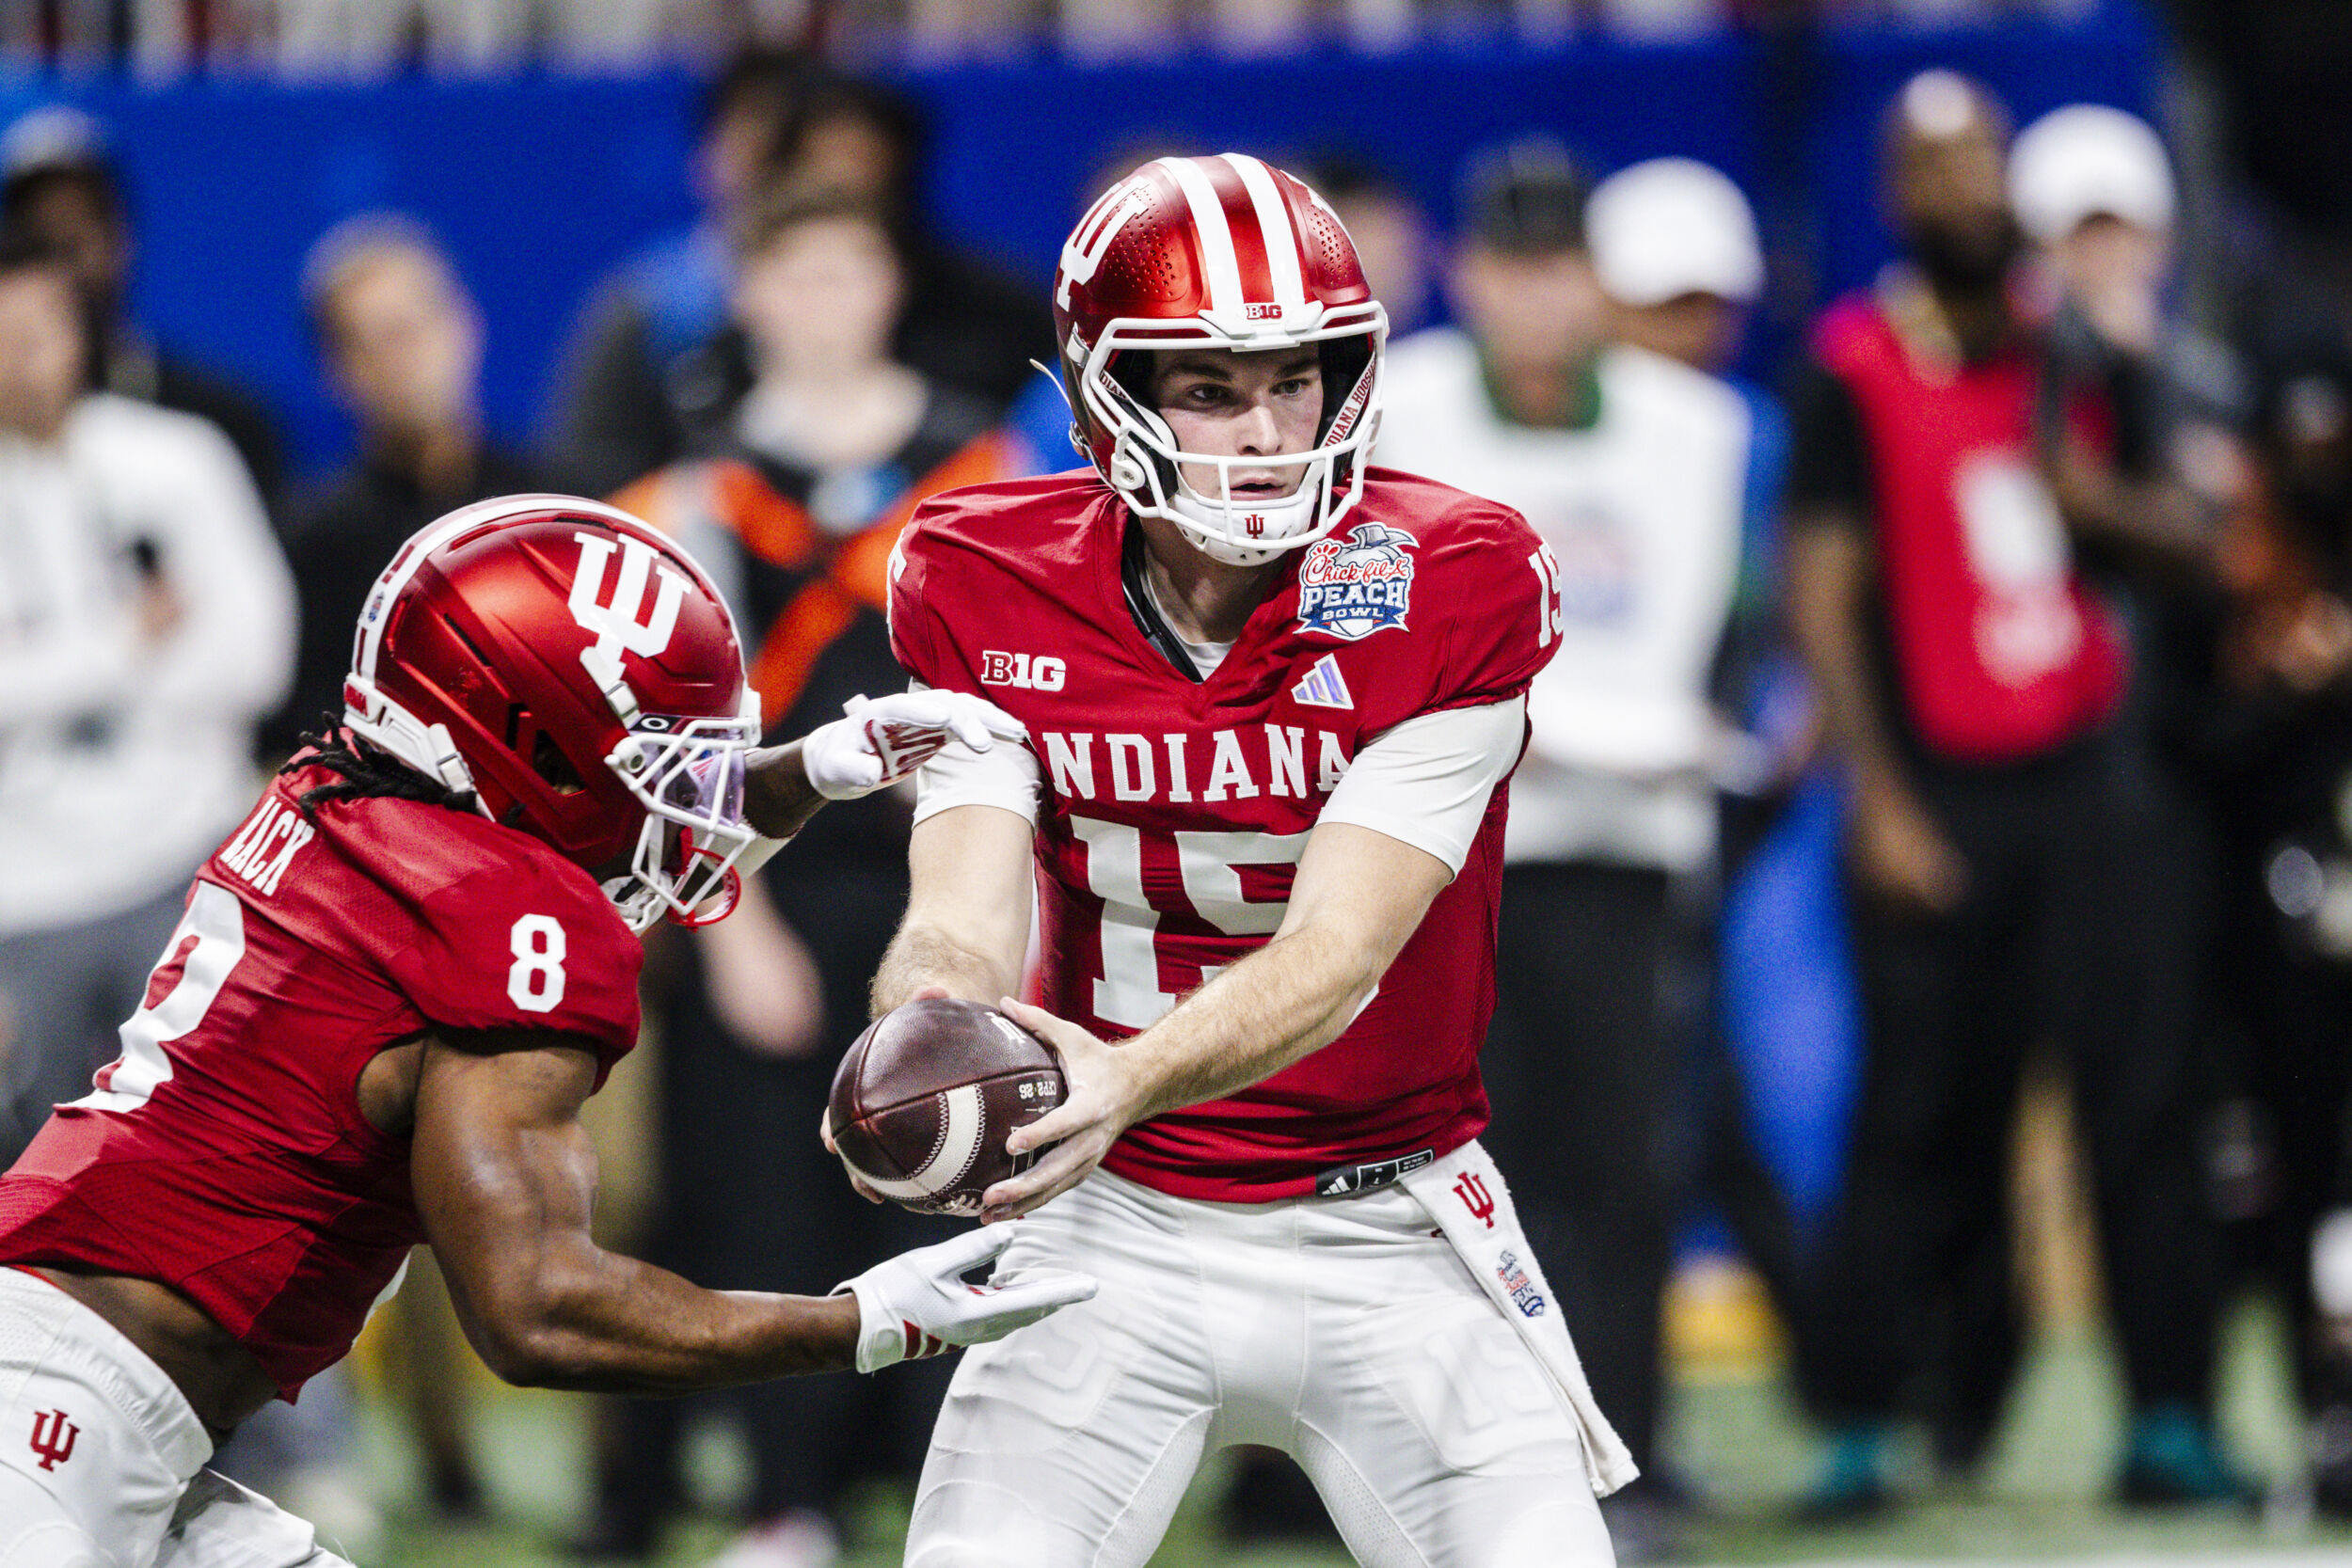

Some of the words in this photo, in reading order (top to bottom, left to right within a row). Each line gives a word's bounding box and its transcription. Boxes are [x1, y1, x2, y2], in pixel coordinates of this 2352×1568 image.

[1306, 553, 1406, 583] Chick-fil-A
[1302, 580, 1406, 614] PEACH
[1322, 607, 1384, 621] BOWL
[1069, 814, 1380, 1030] 15
[507, 913, 565, 1013] 8
